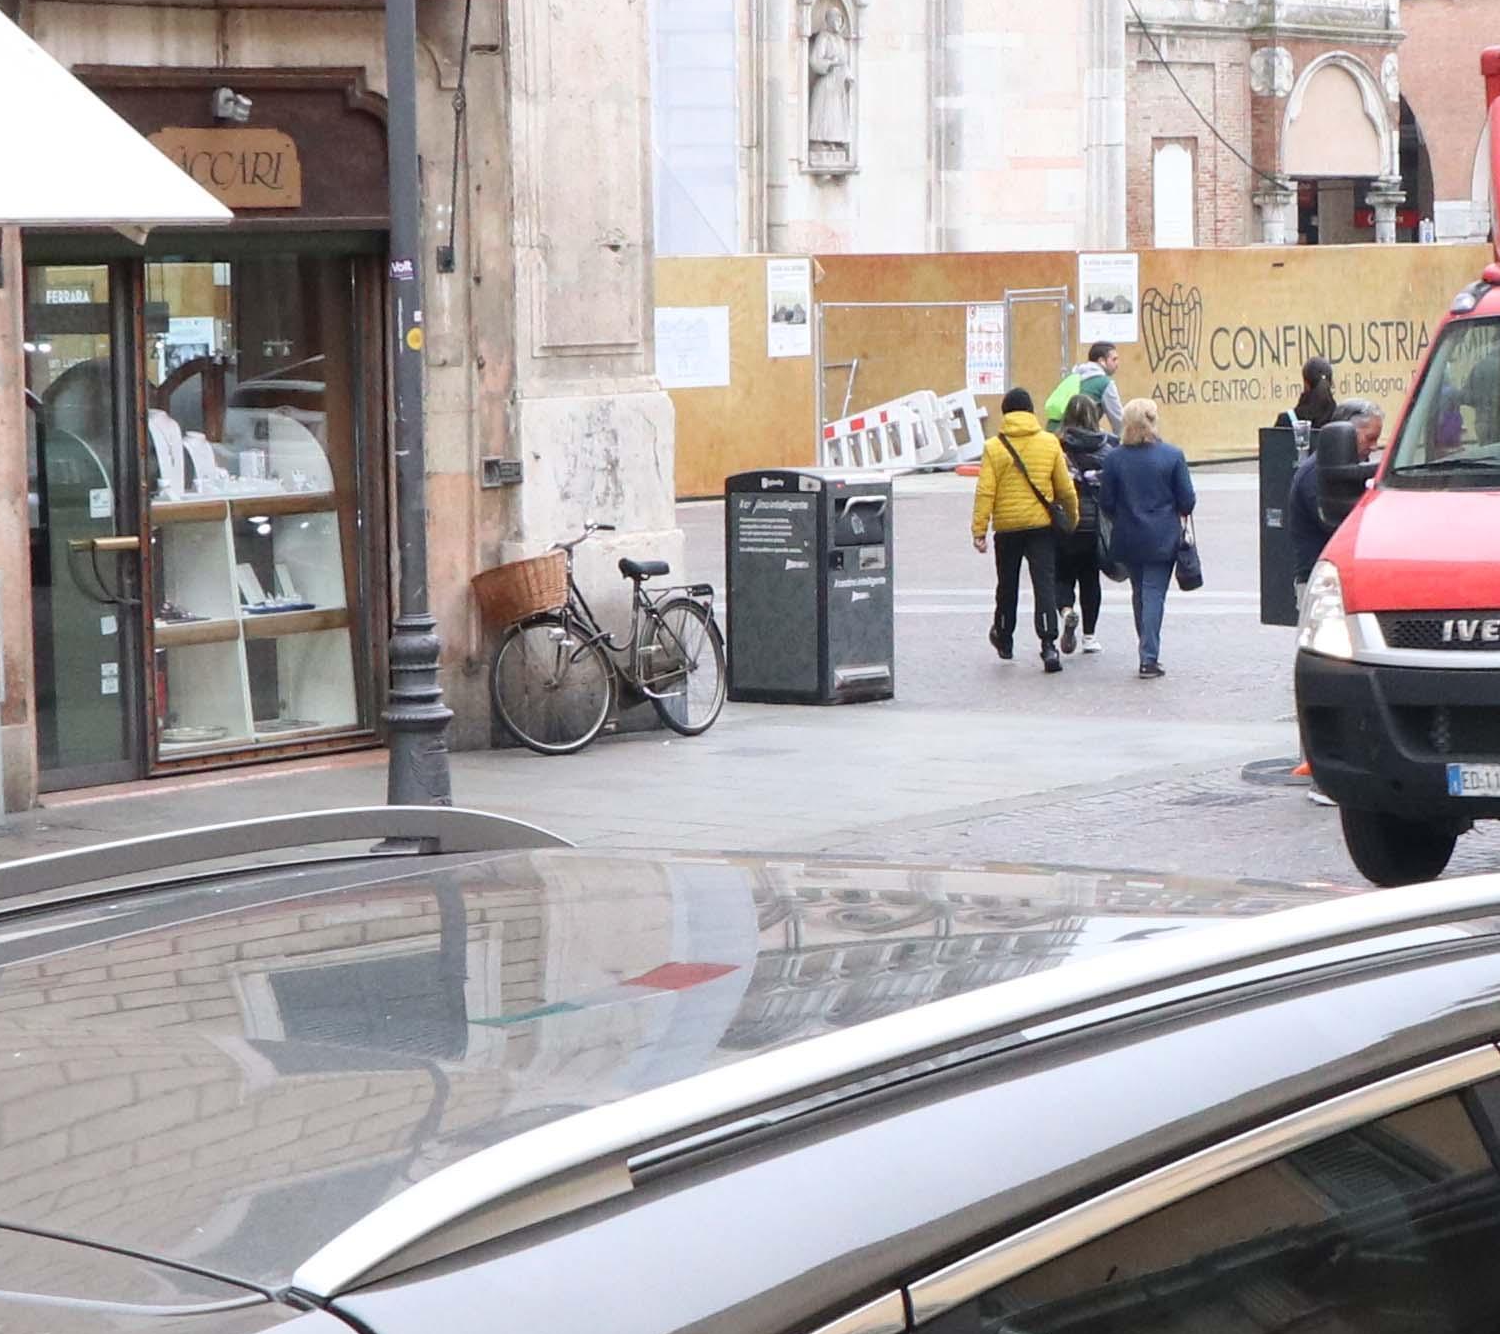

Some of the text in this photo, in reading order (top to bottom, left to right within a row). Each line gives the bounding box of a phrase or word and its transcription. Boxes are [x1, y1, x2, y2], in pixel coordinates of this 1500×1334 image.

[1209, 320, 1430, 372] CONFINDUSTRIA
[1151, 381, 1196, 405] AREA
[1201, 378, 1267, 404] CENTRO:
